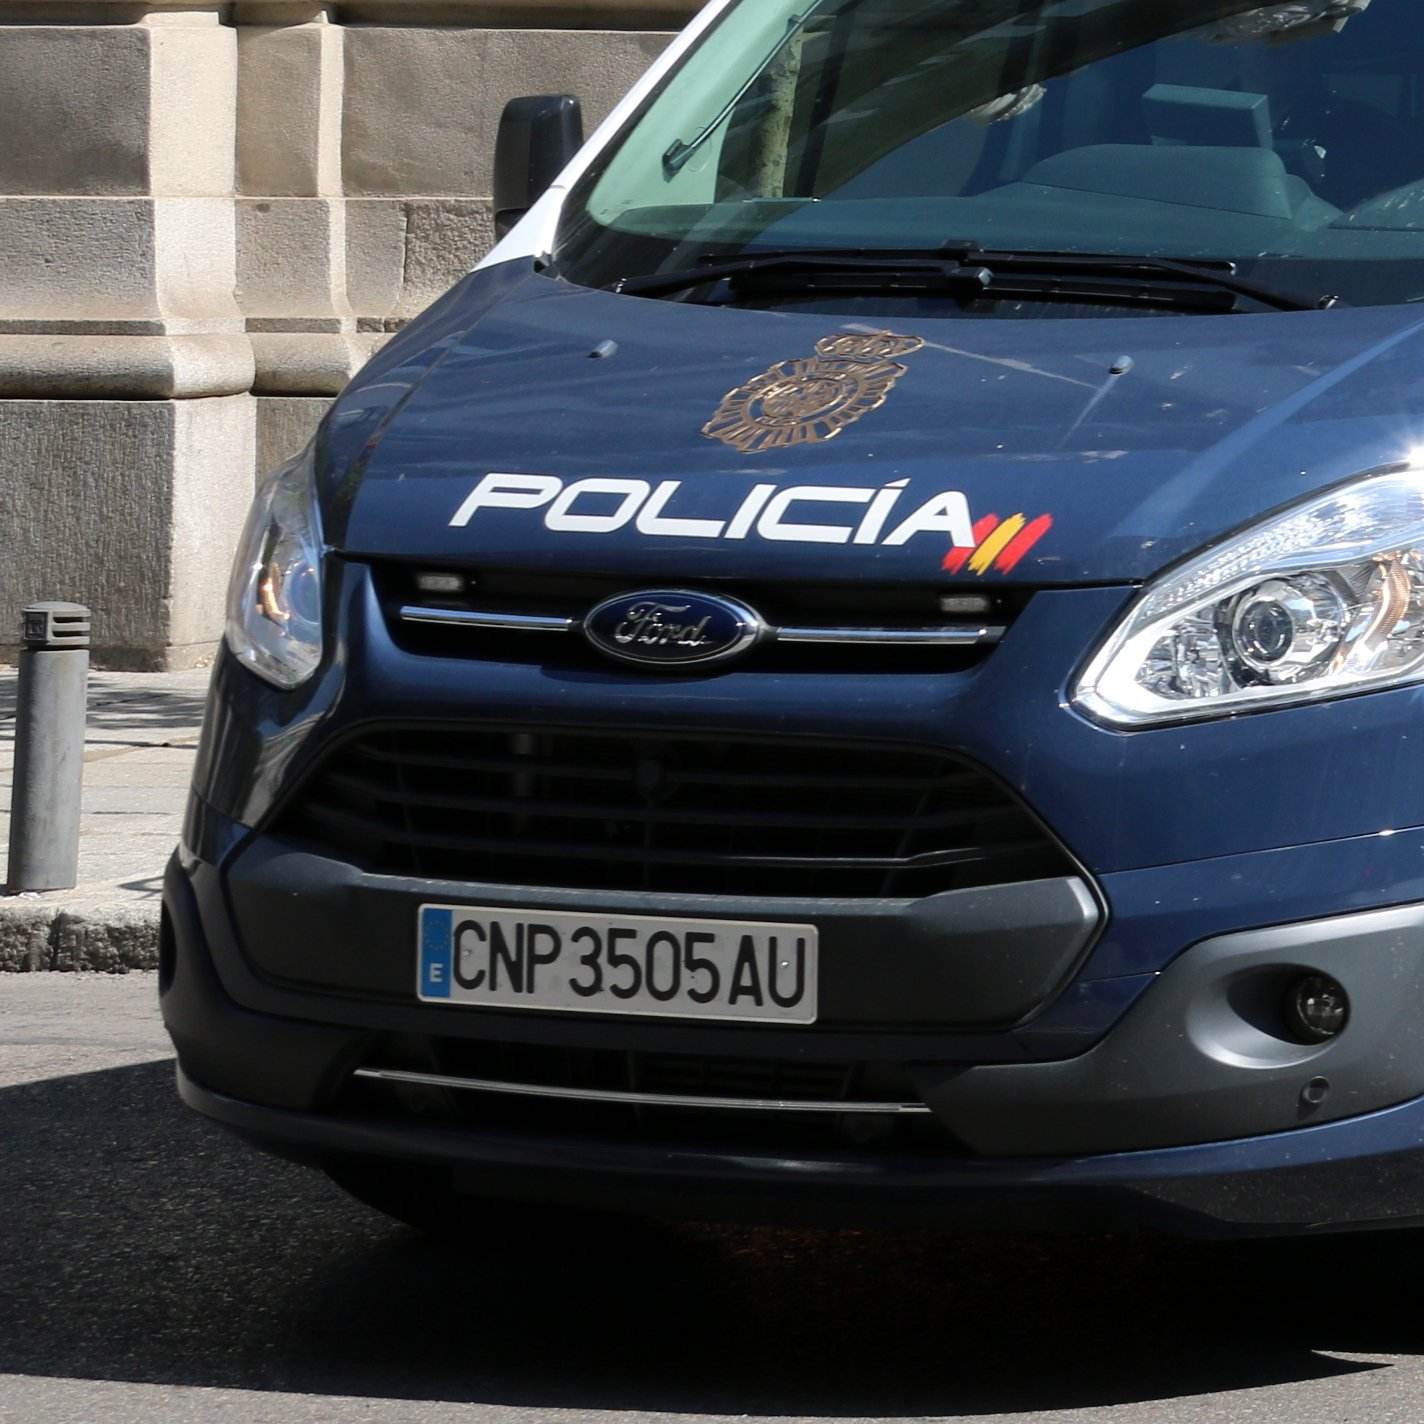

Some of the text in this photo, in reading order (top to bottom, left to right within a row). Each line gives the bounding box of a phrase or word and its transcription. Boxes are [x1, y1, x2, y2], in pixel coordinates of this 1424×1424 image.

[448, 473, 976, 548] POLICÍA
[615, 601, 713, 646] Ford
[428, 963, 443, 982] E
